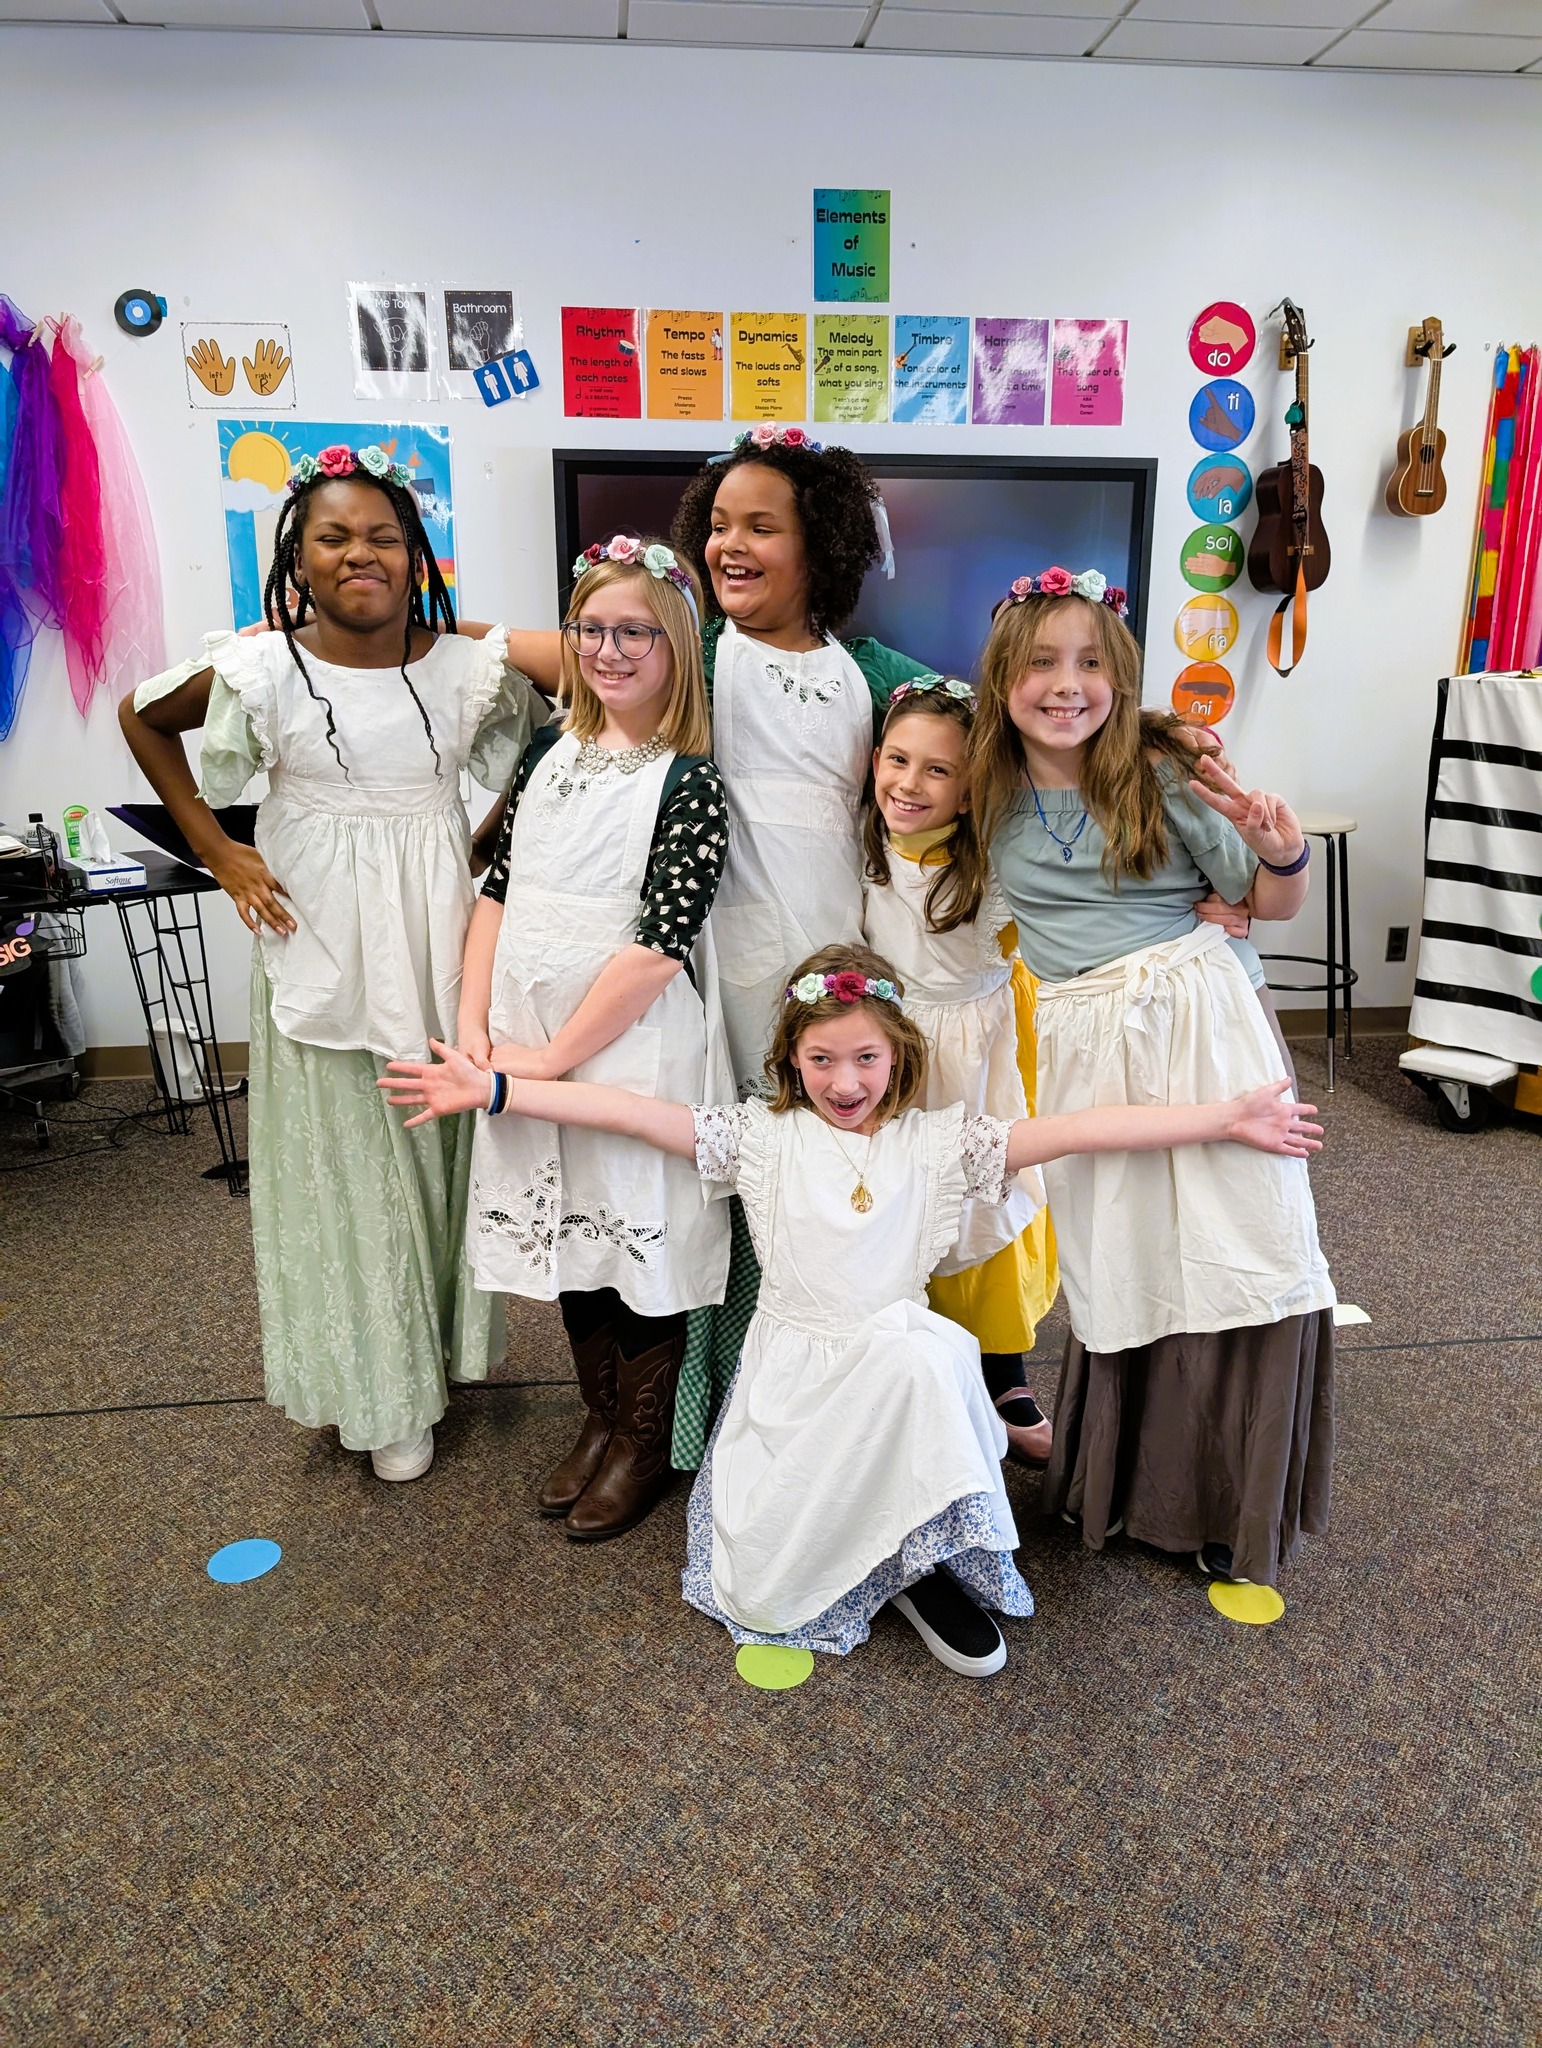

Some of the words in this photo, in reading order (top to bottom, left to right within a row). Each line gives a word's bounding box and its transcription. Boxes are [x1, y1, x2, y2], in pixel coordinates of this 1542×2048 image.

[816, 208, 886, 224] Elements
[844, 235, 859, 250] of
[832, 262, 876, 277] Music
[375, 298, 390, 308] Me
[392, 298, 410, 309] Too
[453, 303, 507, 314] Bathroom
[576, 325, 626, 340] Rhythm
[663, 328, 705, 343] Tempo
[739, 330, 798, 344] Dynamics
[829, 332, 873, 346] Melody
[911, 333, 953, 345] Timbre
[661, 350, 678, 360] The
[681, 350, 705, 360] fasts
[817, 347, 834, 356] The
[837, 347, 859, 356] main
[862, 349, 882, 358] part
[1208, 349, 1231, 367] do
[570, 356, 588, 366] The
[590, 357, 620, 368] length
[623, 358, 633, 367] of
[736, 361, 753, 370] The
[755, 362, 780, 371] louds
[783, 363, 801, 371] and
[834, 362, 843, 372] of
[854, 365, 879, 374] song,
[660, 366, 678, 375] and
[681, 367, 707, 376] slows
[902, 364, 924, 372] Tone
[926, 364, 948, 373] color
[951, 365, 960, 374] of
[1057, 368, 1074, 376] The
[1103, 368, 1112, 376] of
[209, 371, 223, 379] left
[255, 372, 272, 380] right
[576, 374, 598, 382] each
[601, 375, 628, 383] notes
[757, 377, 780, 386] softs
[214, 379, 225, 392] L
[260, 378, 271, 393] R
[818, 379, 842, 387] what
[845, 380, 861, 390] you
[864, 379, 883, 390] sing
[895, 380, 909, 388] the
[912, 380, 966, 389] instruments
[1021, 383, 1041, 391] time
[1077, 384, 1099, 394] song
[1227, 393, 1240, 411] ti
[1218, 498, 1232, 515] la
[1205, 535, 1232, 552] sol
[1208, 634, 1227, 650] fa
[1191, 699, 1213, 715] mi
